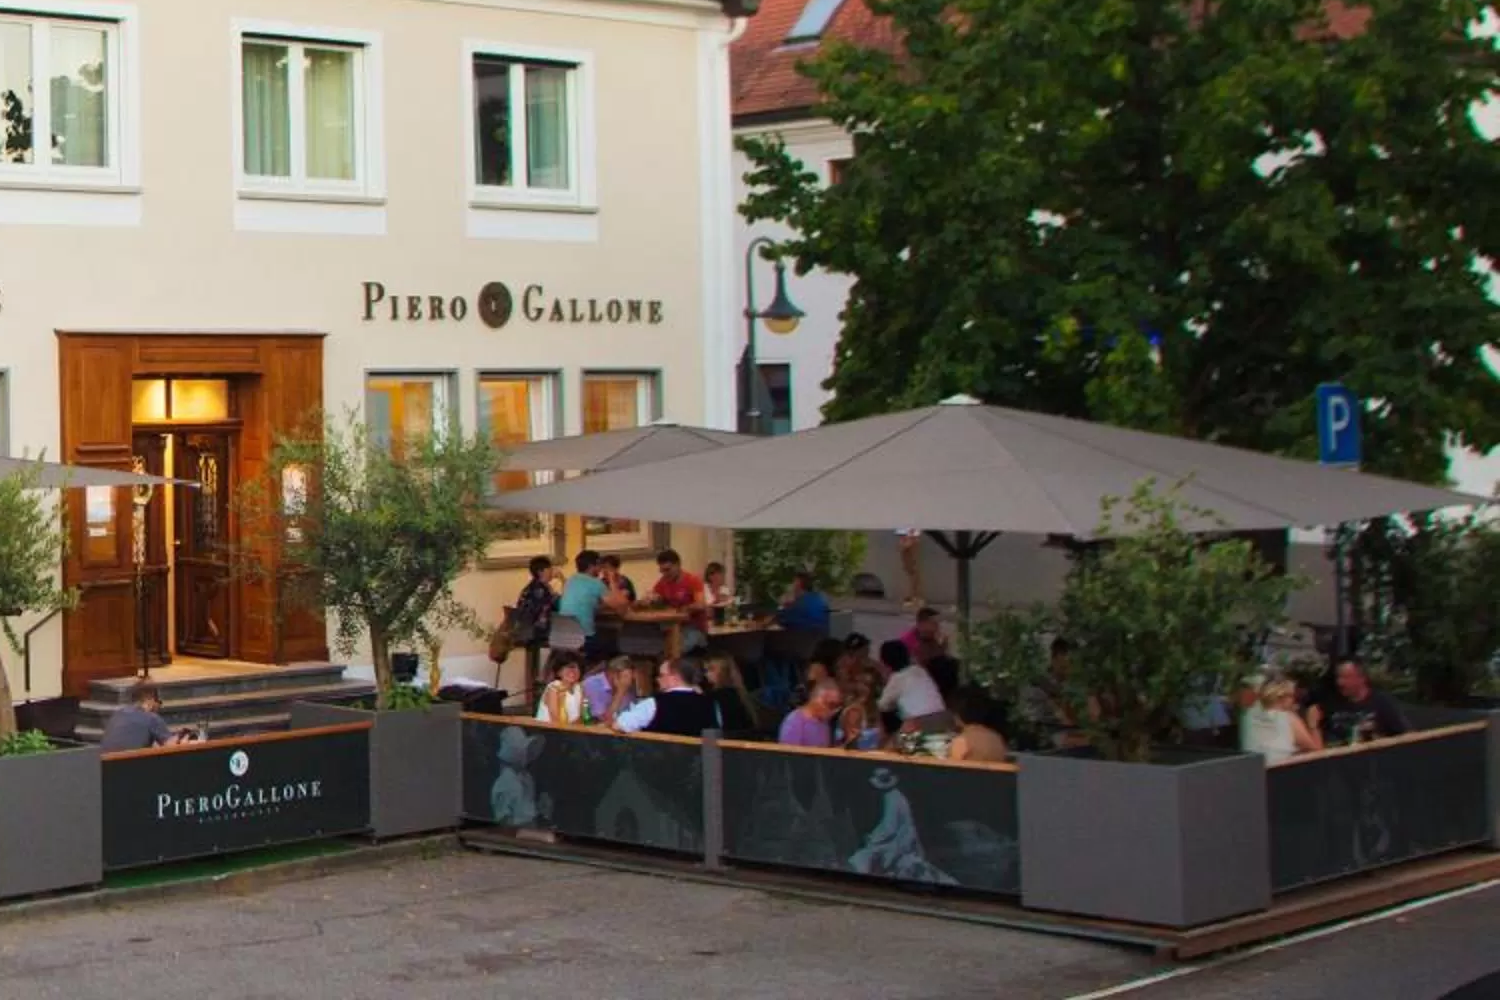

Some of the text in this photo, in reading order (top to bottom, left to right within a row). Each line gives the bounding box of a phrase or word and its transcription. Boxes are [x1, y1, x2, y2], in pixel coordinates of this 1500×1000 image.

[361, 281, 665, 325] PIERO GALLONE
[1328, 395, 1350, 452] P
